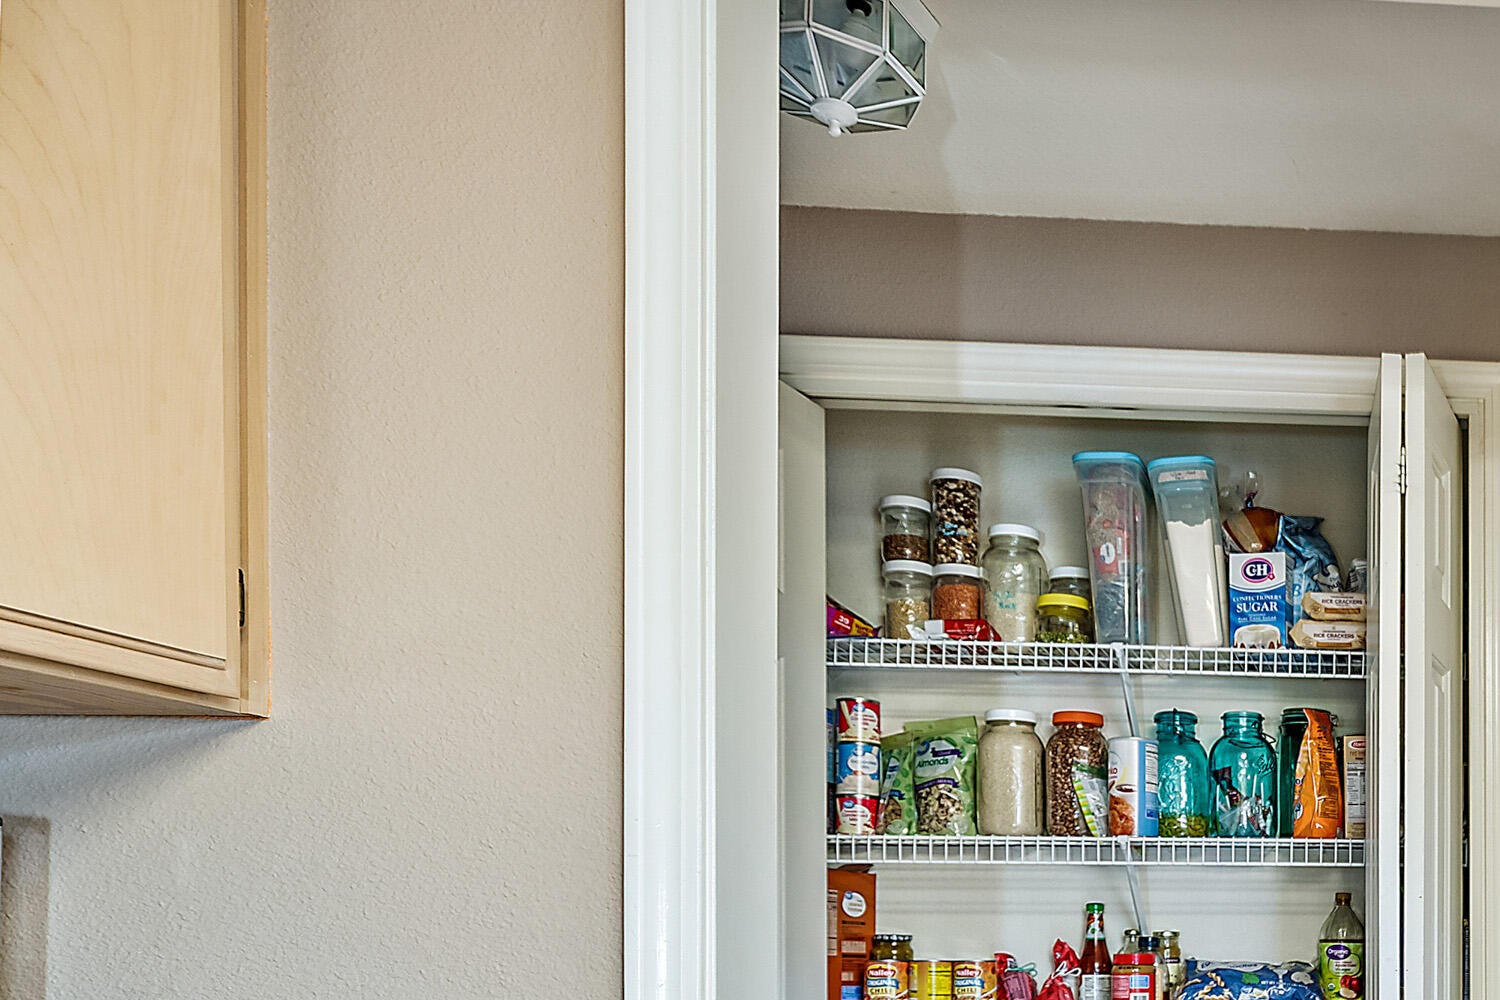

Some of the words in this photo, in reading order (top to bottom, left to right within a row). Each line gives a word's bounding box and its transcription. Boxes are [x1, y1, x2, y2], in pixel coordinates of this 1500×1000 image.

[1236, 602, 1279, 613] SUGAR
[916, 757, 949, 768] Almonds
[869, 968, 895, 977] Nalley
[956, 968, 980, 977] Nalley
